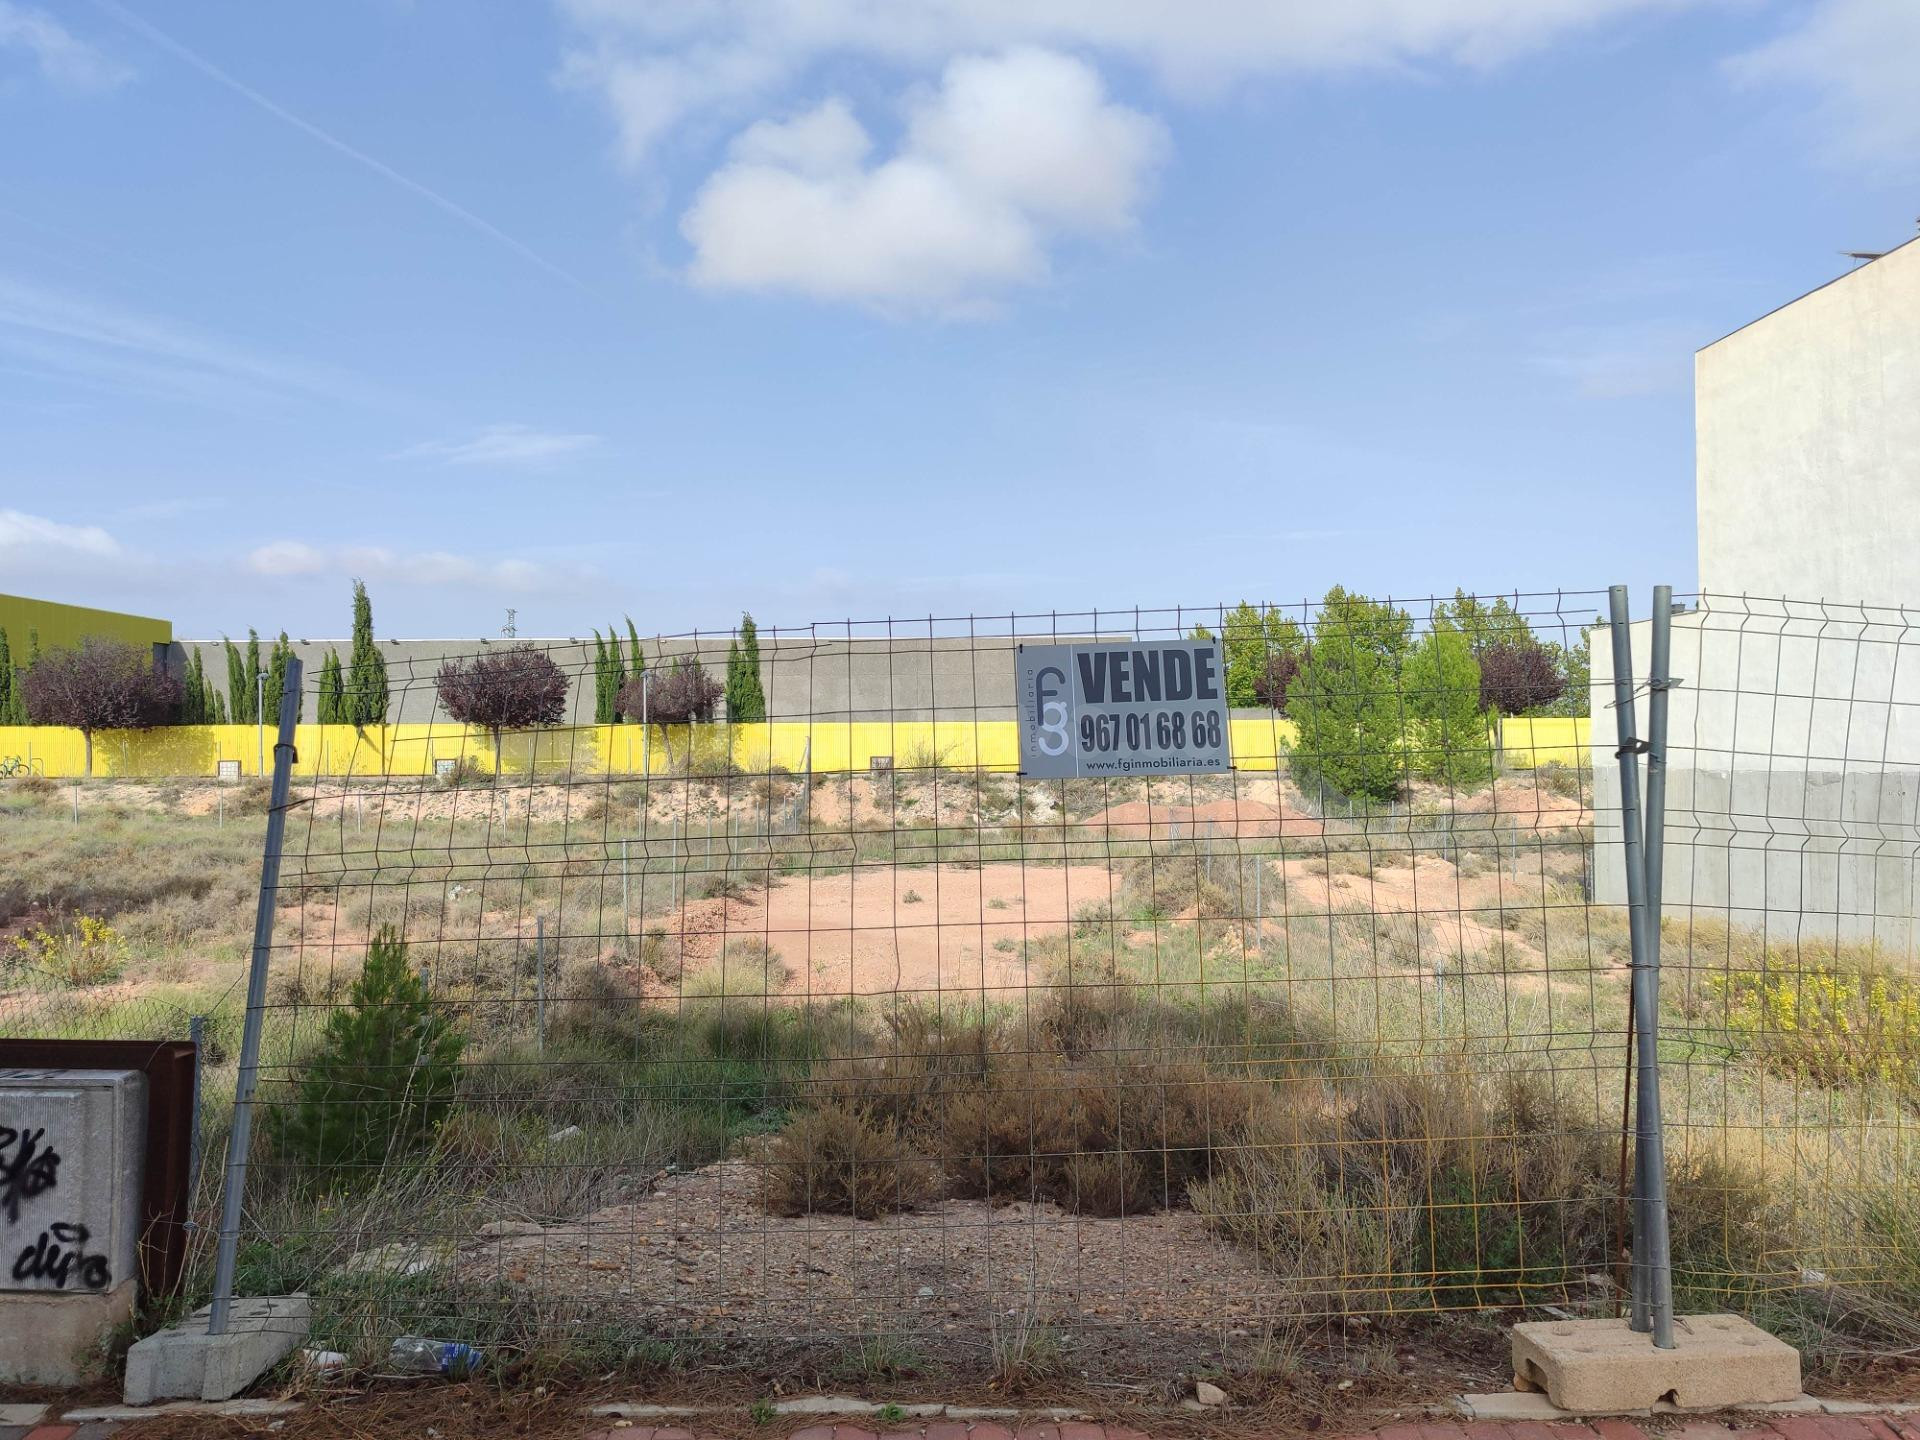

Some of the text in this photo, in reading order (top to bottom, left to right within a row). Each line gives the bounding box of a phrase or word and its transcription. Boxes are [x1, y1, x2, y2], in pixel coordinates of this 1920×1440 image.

[1077, 648, 1218, 703] VENDE
[1024, 669, 1037, 760] inmobiliaria
[1080, 709, 1222, 752] 967 01 68 68
[1086, 756, 1221, 772] www.fginmobiliaria.es
